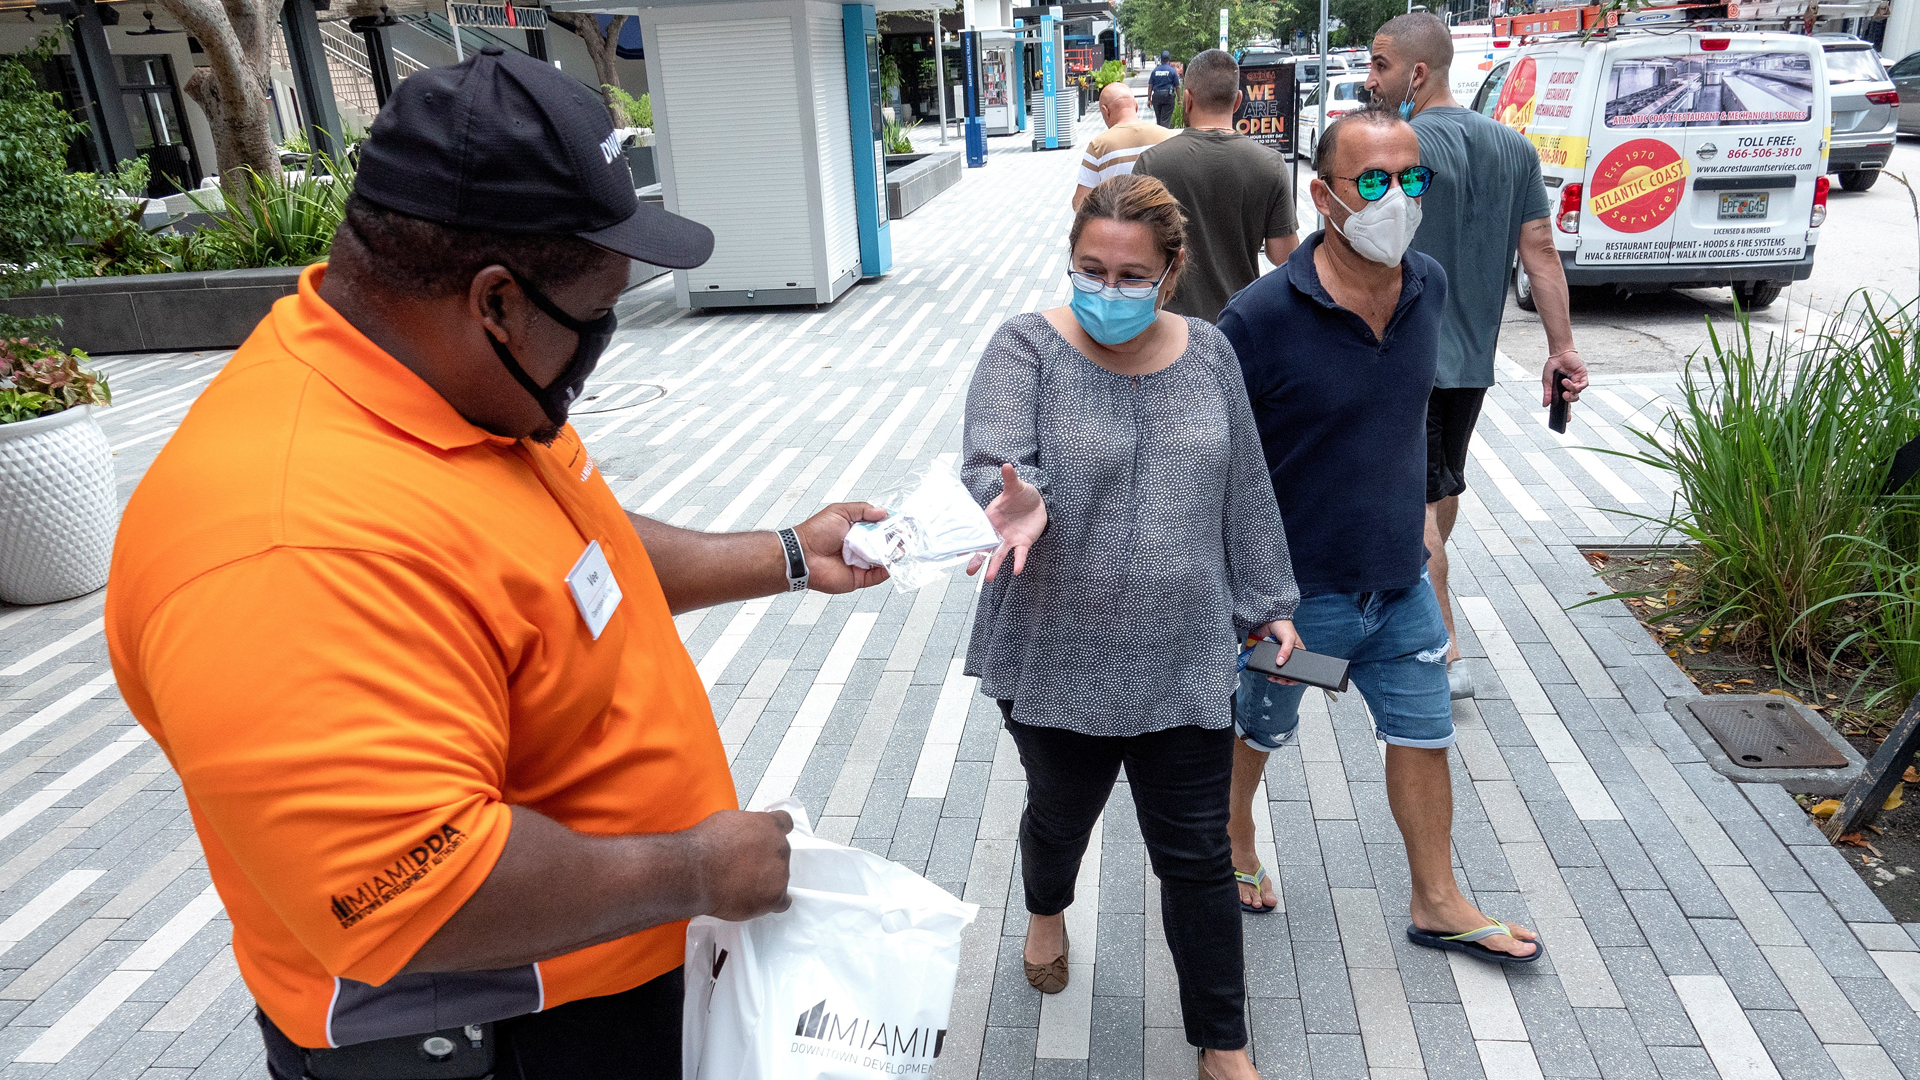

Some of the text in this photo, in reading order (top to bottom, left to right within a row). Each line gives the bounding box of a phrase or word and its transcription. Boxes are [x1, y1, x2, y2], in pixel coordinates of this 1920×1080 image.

[454, 4, 548, 28] TOSCANA DIVINO
[1246, 83, 1275, 101] WE
[1243, 100, 1278, 119] ARE
[1613, 110, 1807, 125] ATLANTIC COAST RESTAURANT & MECHANICAL SERVICES
[1235, 117, 1285, 134] OPEN
[1539, 136, 1549, 148] TOLL
[1738, 136, 1796, 147] TOLL FREE:
[1625, 150, 1655, 162] 1970
[1727, 147, 1802, 159] 866-506-3810
[1696, 162, 1812, 173] www.acrestaurantservices.com
[1594, 162, 1684, 212] ATLANTIC COAST
[1713, 227, 1740, 235] LICENSED
[1605, 238, 1785, 250] RESTAURANT EQUIPMENT HOODS & FIRE SYSTEMS
[1584, 247, 1801, 260] HVAC & REFRIGERATION WALK IN COOLERS CUSTOM S/S FAB
[586, 571, 599, 586] Vee
[340, 833, 469, 929] DOWNTOWN DEVELOPMENT AUTHORITY
[790, 1042, 858, 1064] DOWNTOWN
